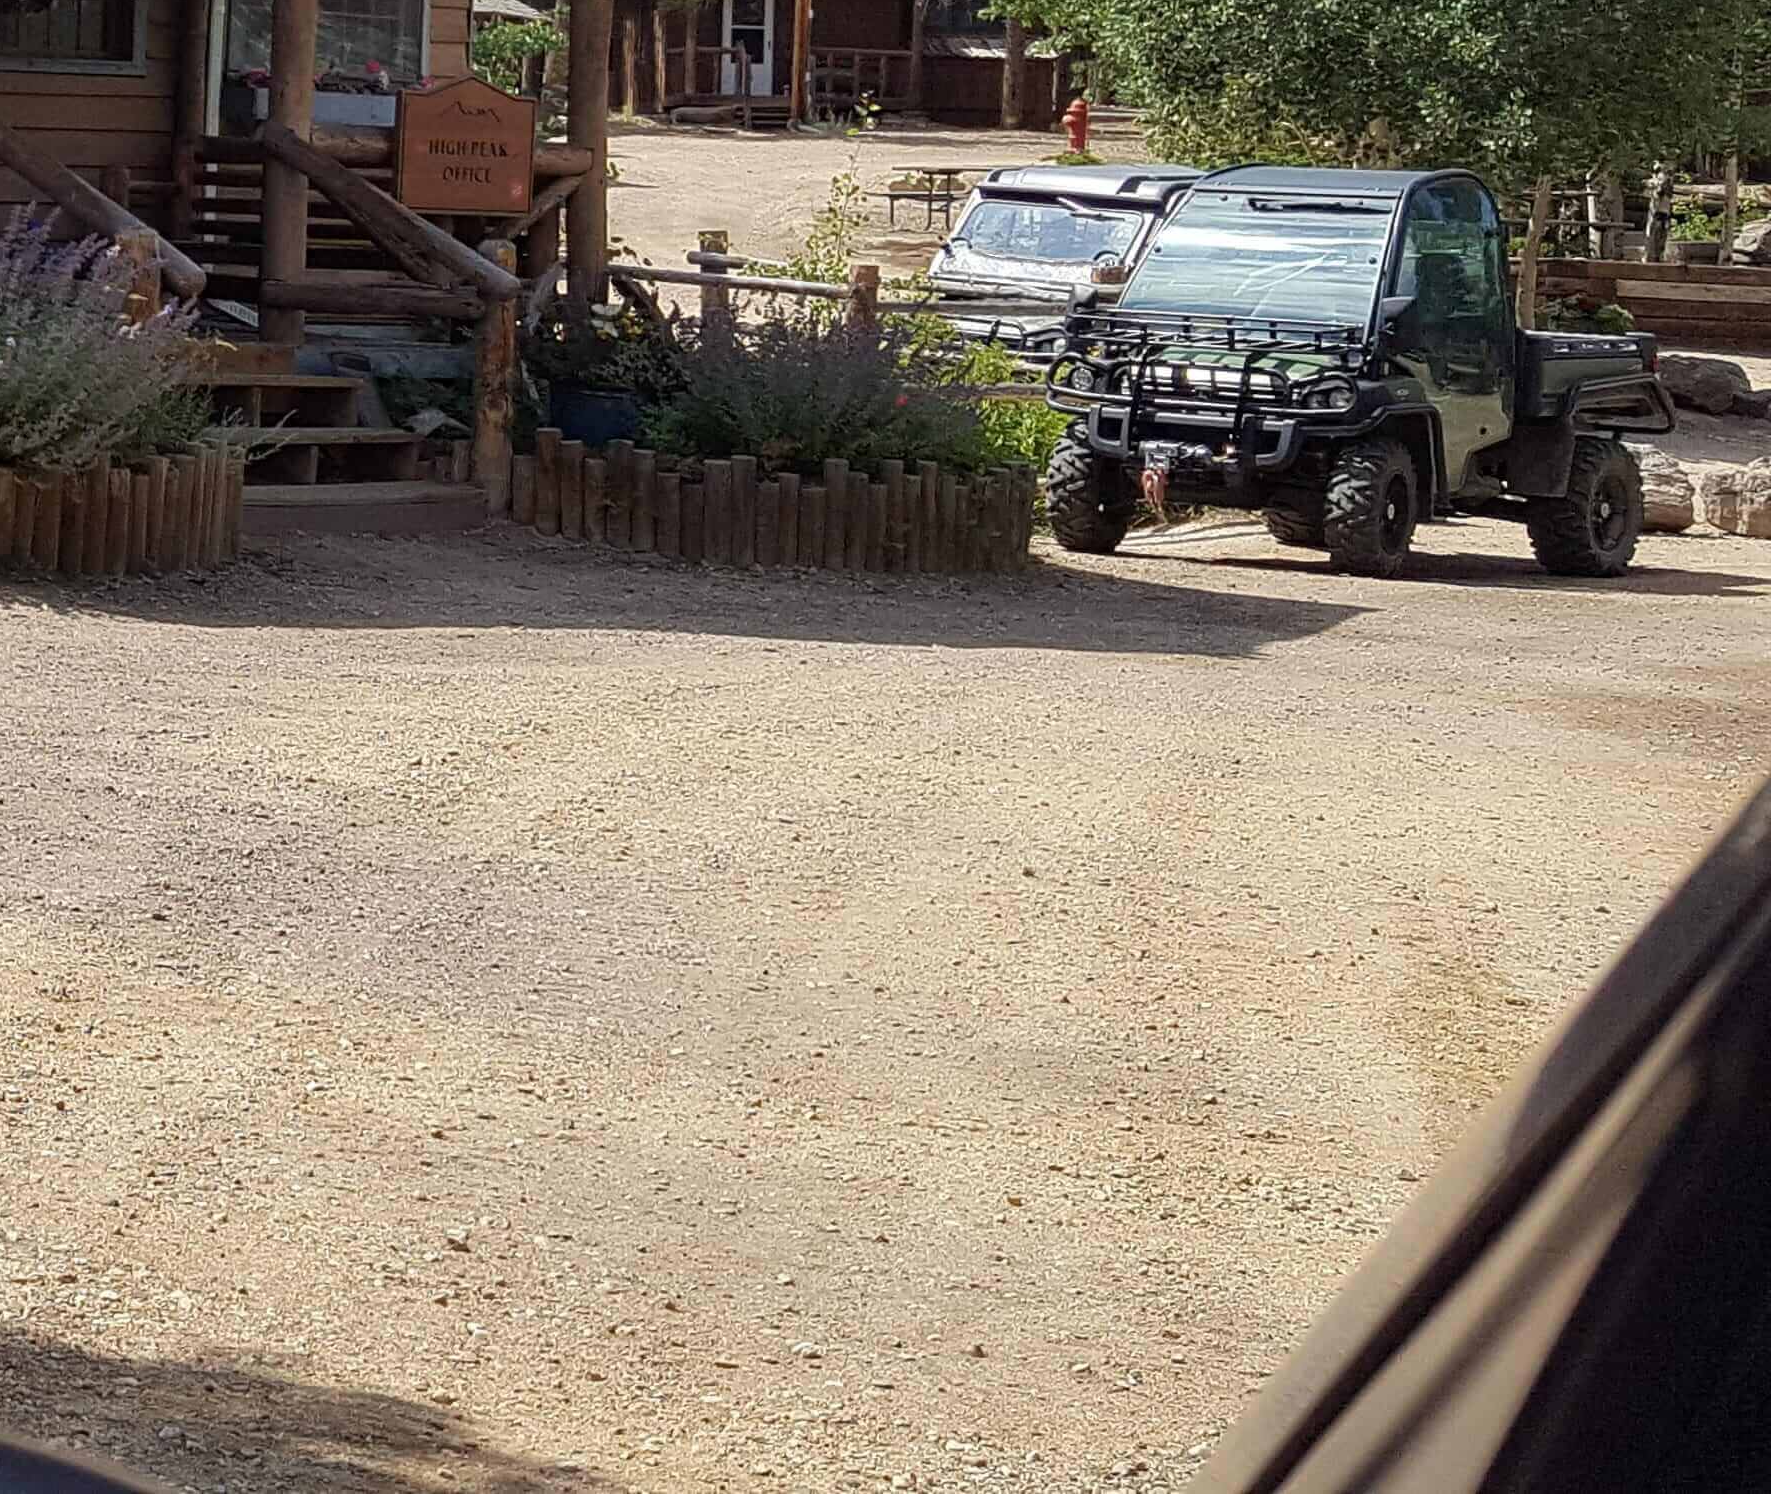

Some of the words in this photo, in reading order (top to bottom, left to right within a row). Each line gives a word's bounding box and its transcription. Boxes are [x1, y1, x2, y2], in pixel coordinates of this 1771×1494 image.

[429, 140, 466, 155] HIGH
[471, 142, 507, 157] PEAK
[443, 166, 491, 183] OFFICE
